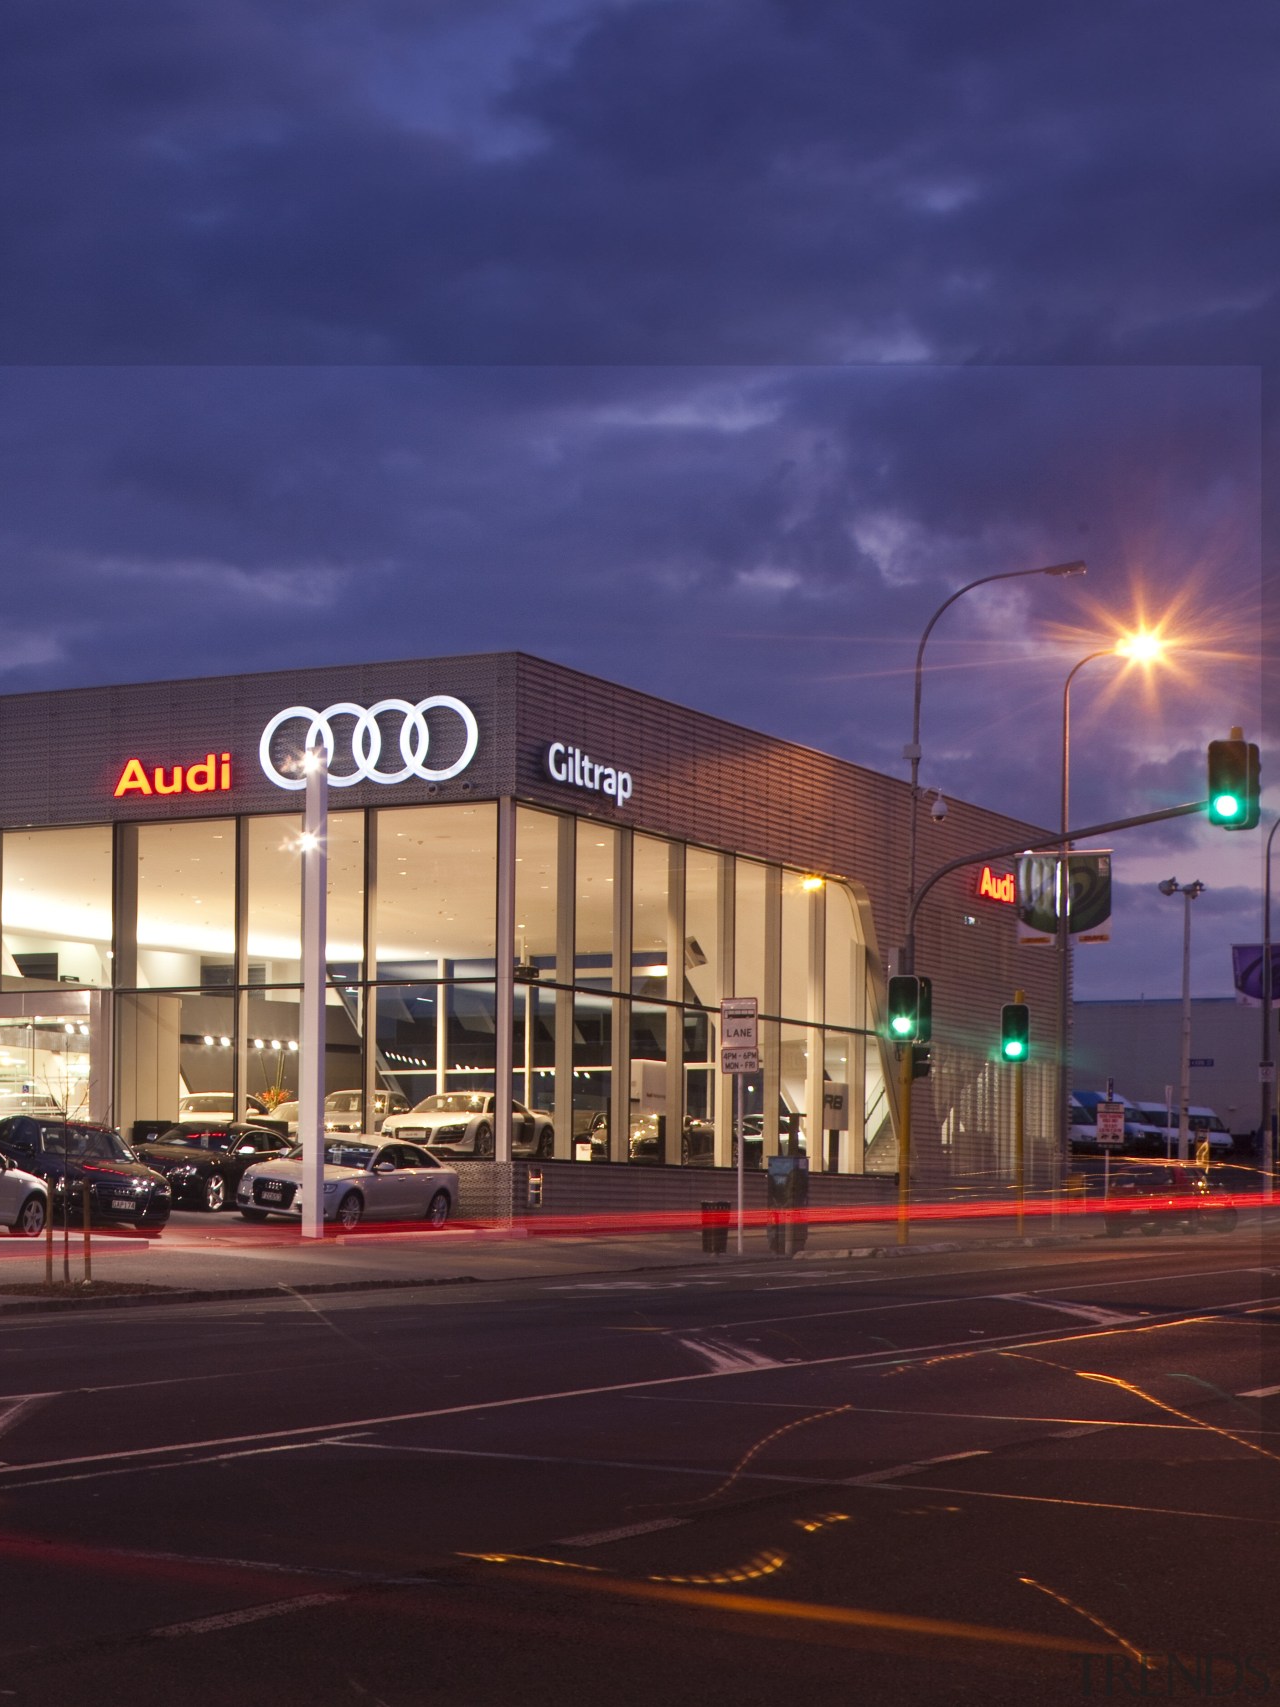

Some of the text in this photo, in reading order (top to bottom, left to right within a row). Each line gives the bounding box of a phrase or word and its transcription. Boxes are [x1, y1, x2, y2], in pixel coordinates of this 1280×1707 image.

[113, 752, 231, 798] Audi
[548, 742, 633, 807] Giltrap
[980, 866, 1015, 903] Audi
[726, 1028, 753, 1038] LANE
[744, 1061, 756, 1069] FRI
